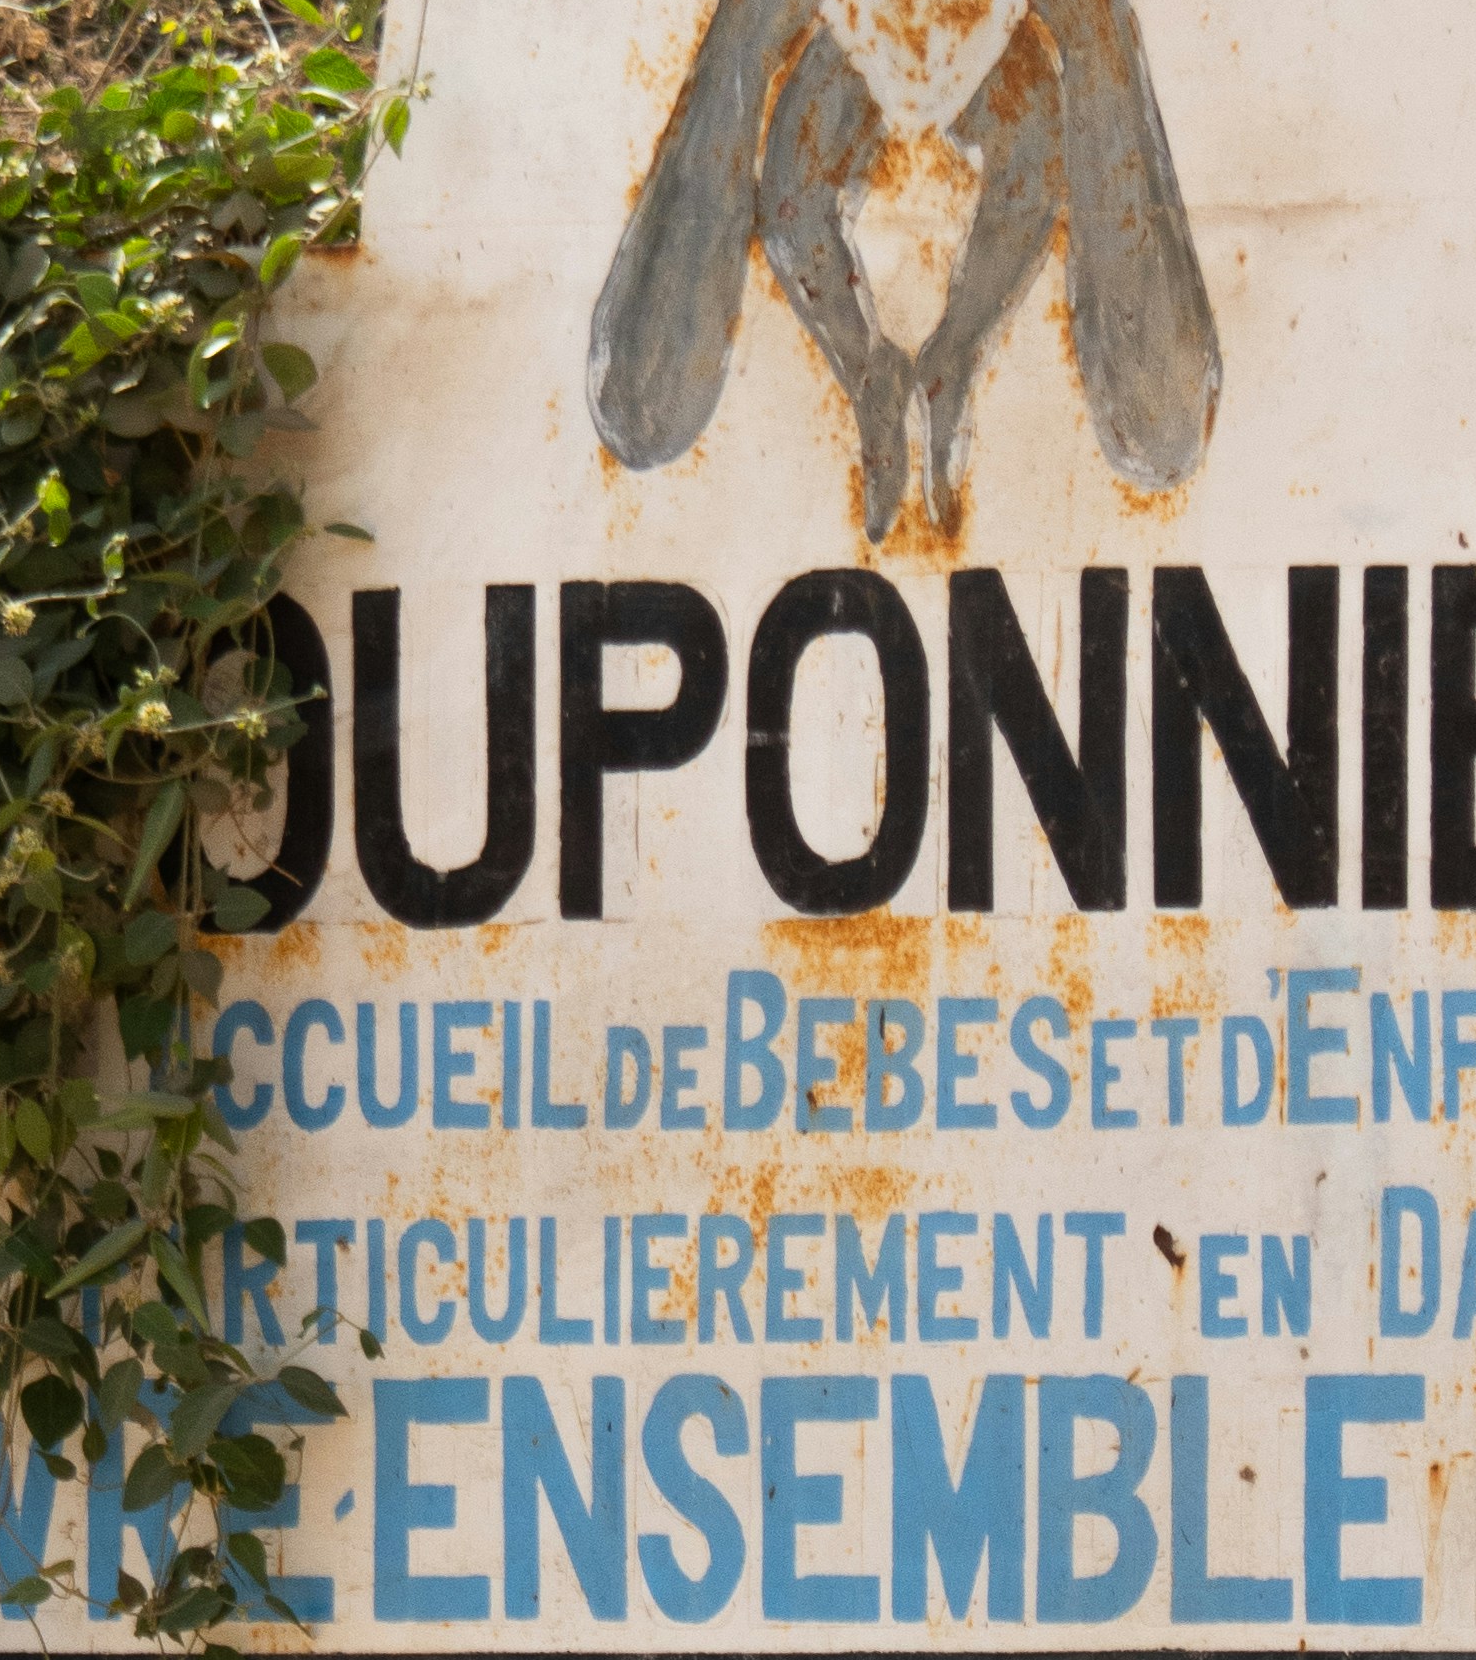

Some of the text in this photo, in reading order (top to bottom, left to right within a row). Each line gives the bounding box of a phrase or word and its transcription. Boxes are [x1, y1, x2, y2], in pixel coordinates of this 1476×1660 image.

[85, 1211, 1127, 1346] RTICULIEREMENT
[1198, 1232, 1313, 1340] EN
[372, 1372, 1425, 1628] ENSEMBLE
